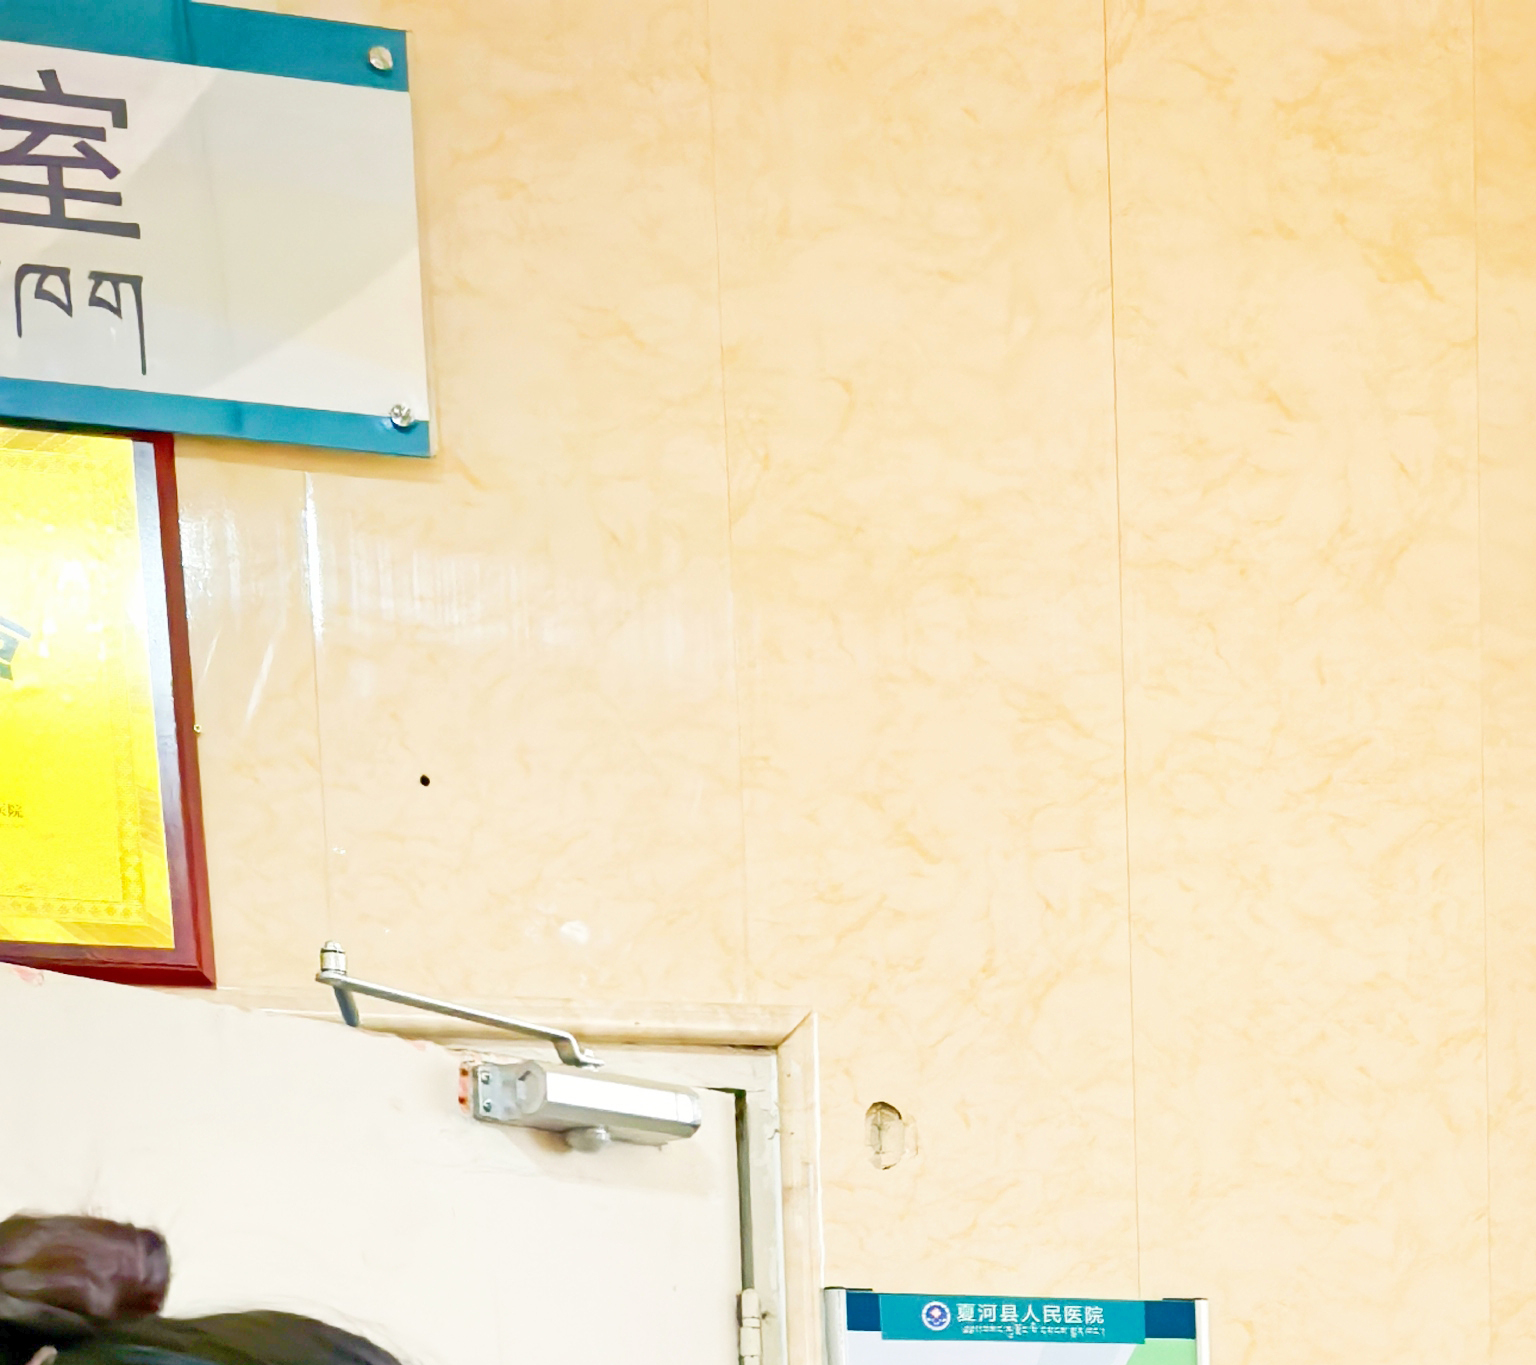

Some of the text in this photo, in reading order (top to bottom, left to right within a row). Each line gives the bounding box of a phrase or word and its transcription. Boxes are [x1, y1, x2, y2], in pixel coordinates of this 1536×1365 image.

[0, 68, 141, 239] 室
[956, 1303, 1105, 1325] 夏河县人民医院
